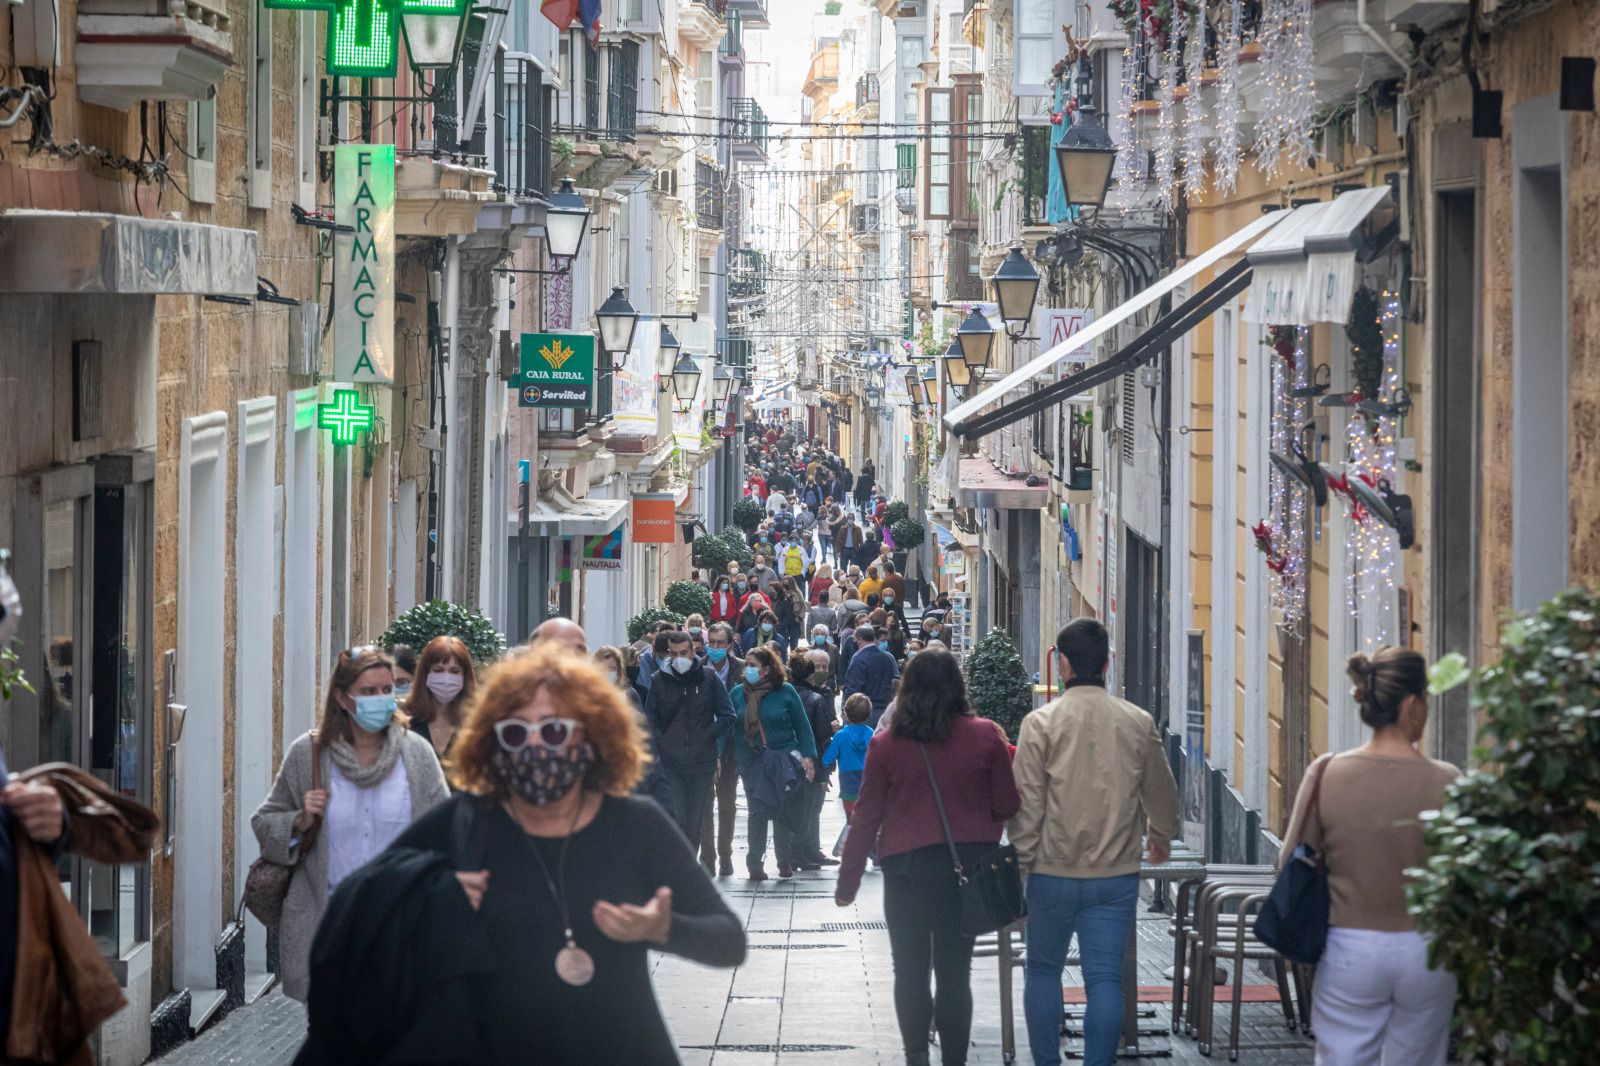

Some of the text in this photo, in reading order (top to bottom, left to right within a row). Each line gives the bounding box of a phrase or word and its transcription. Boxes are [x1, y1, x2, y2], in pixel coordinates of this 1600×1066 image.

[351, 152, 378, 375] FARMACIA
[526, 370, 585, 380] CAJA RURAL
[542, 390, 586, 400] ServiRed
[582, 560, 621, 569] NAUTALIA
